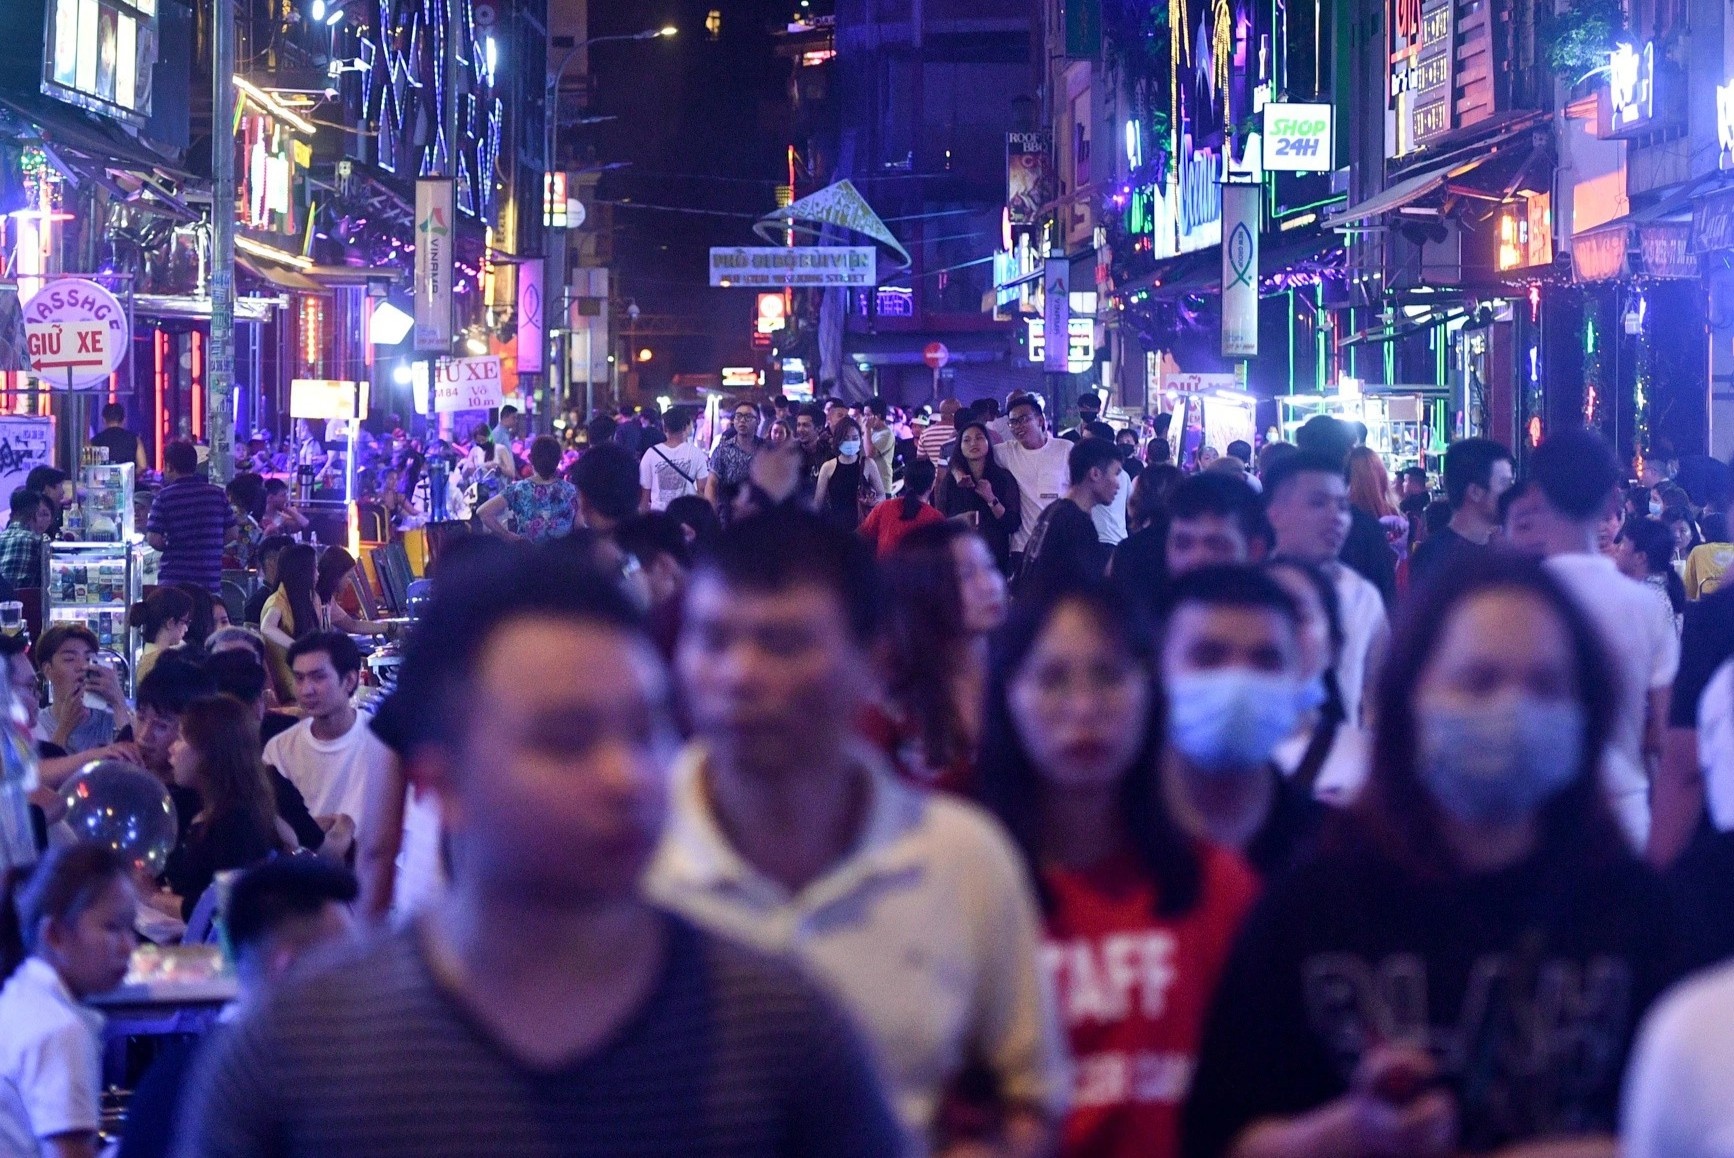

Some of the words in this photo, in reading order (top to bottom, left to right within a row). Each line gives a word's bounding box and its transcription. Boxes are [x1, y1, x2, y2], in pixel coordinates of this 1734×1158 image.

[1269, 119, 1326, 136] SHOP
[1275, 138, 1319, 156] 24H
[27, 289, 120, 330] ASSAGE
[27, 324, 63, 355] GIỮ
[77, 331, 103, 353] XE
[465, 361, 498, 382] XE
[1038, 933, 1179, 1021] TAFF
